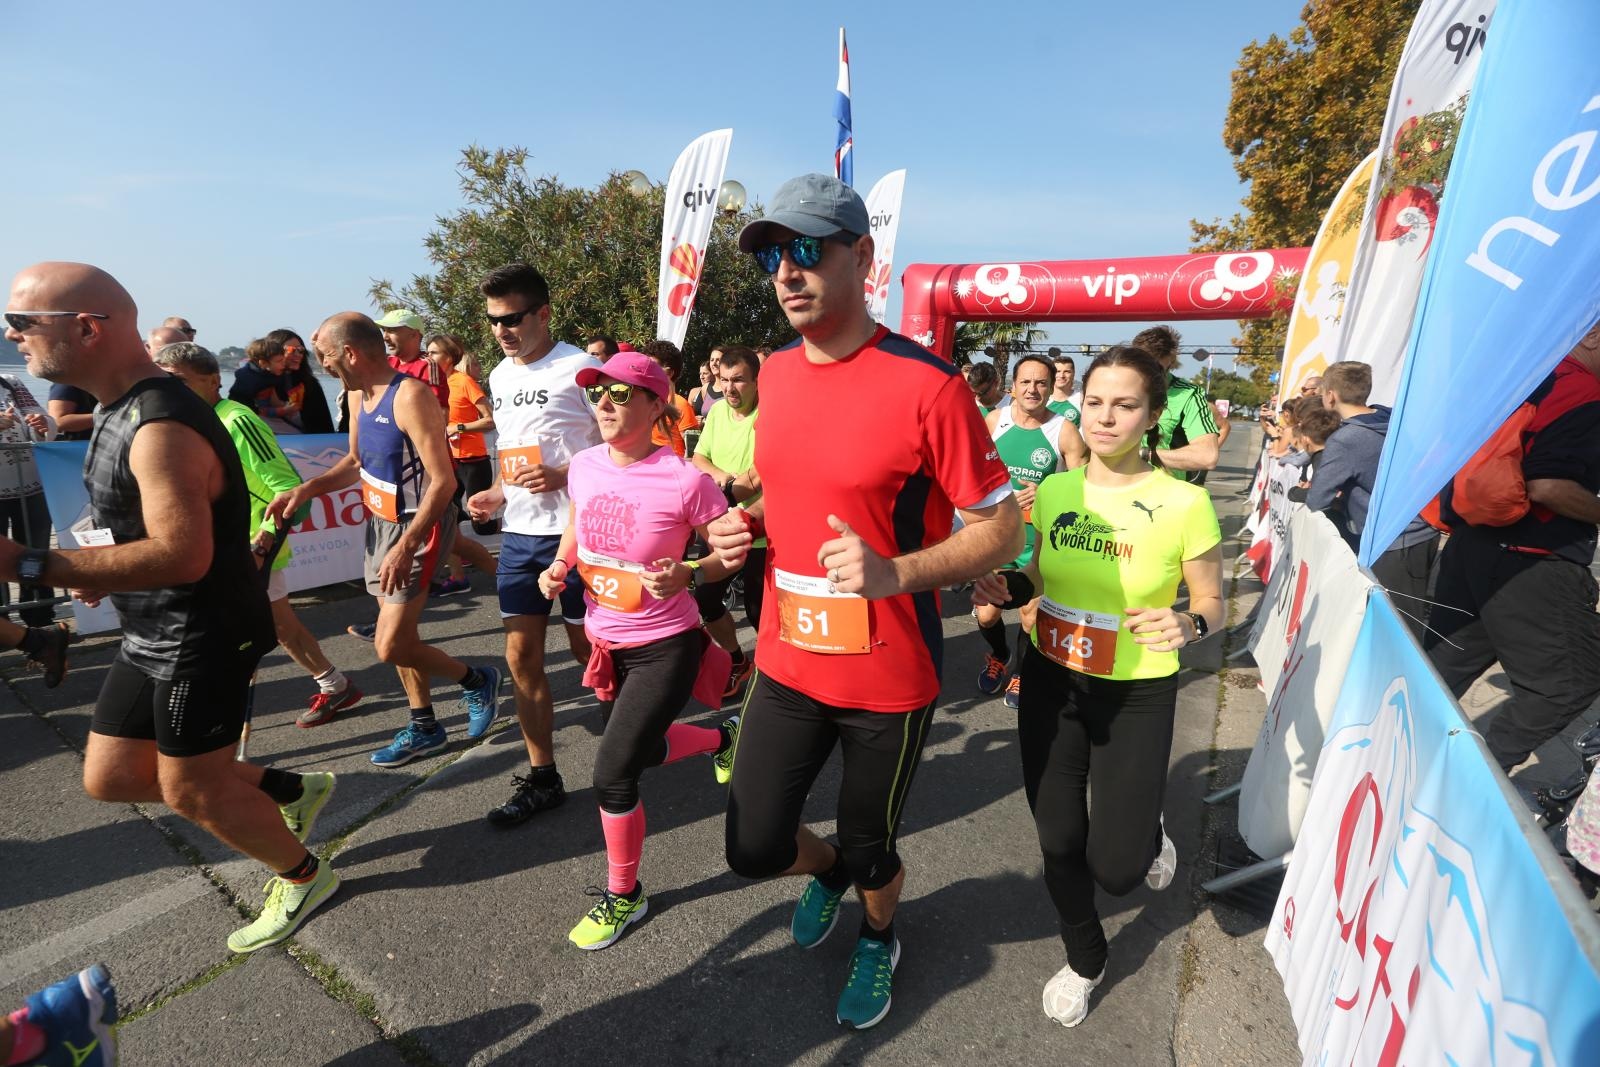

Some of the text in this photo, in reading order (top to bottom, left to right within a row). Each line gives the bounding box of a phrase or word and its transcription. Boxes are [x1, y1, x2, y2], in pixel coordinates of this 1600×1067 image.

[1465, 94, 1600, 291] ne
[1082, 266, 1141, 306] vip
[593, 498, 627, 517] run
[586, 514, 626, 537] with
[319, 540, 350, 551] VODA
[589, 532, 619, 550] me
[1060, 532, 1134, 559] WORLD RUN
[592, 574, 619, 599] 52
[797, 607, 829, 637] 51
[1049, 627, 1093, 659] 143
